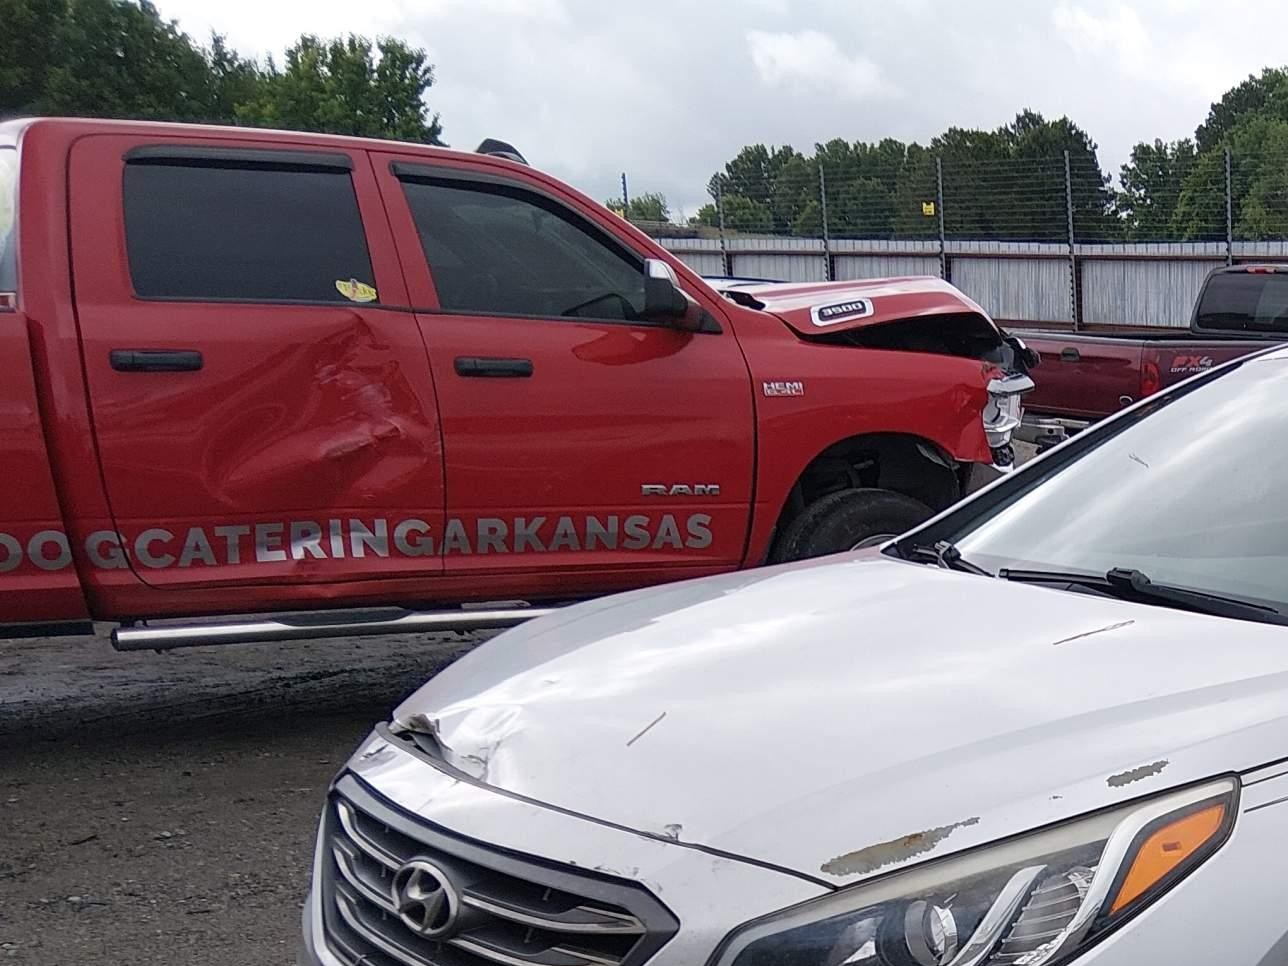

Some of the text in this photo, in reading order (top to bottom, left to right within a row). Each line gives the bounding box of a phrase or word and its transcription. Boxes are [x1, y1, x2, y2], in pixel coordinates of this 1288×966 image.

[822, 302, 863, 316] 3500
[763, 382, 804, 392] HEMI
[641, 484, 720, 495] RAM
